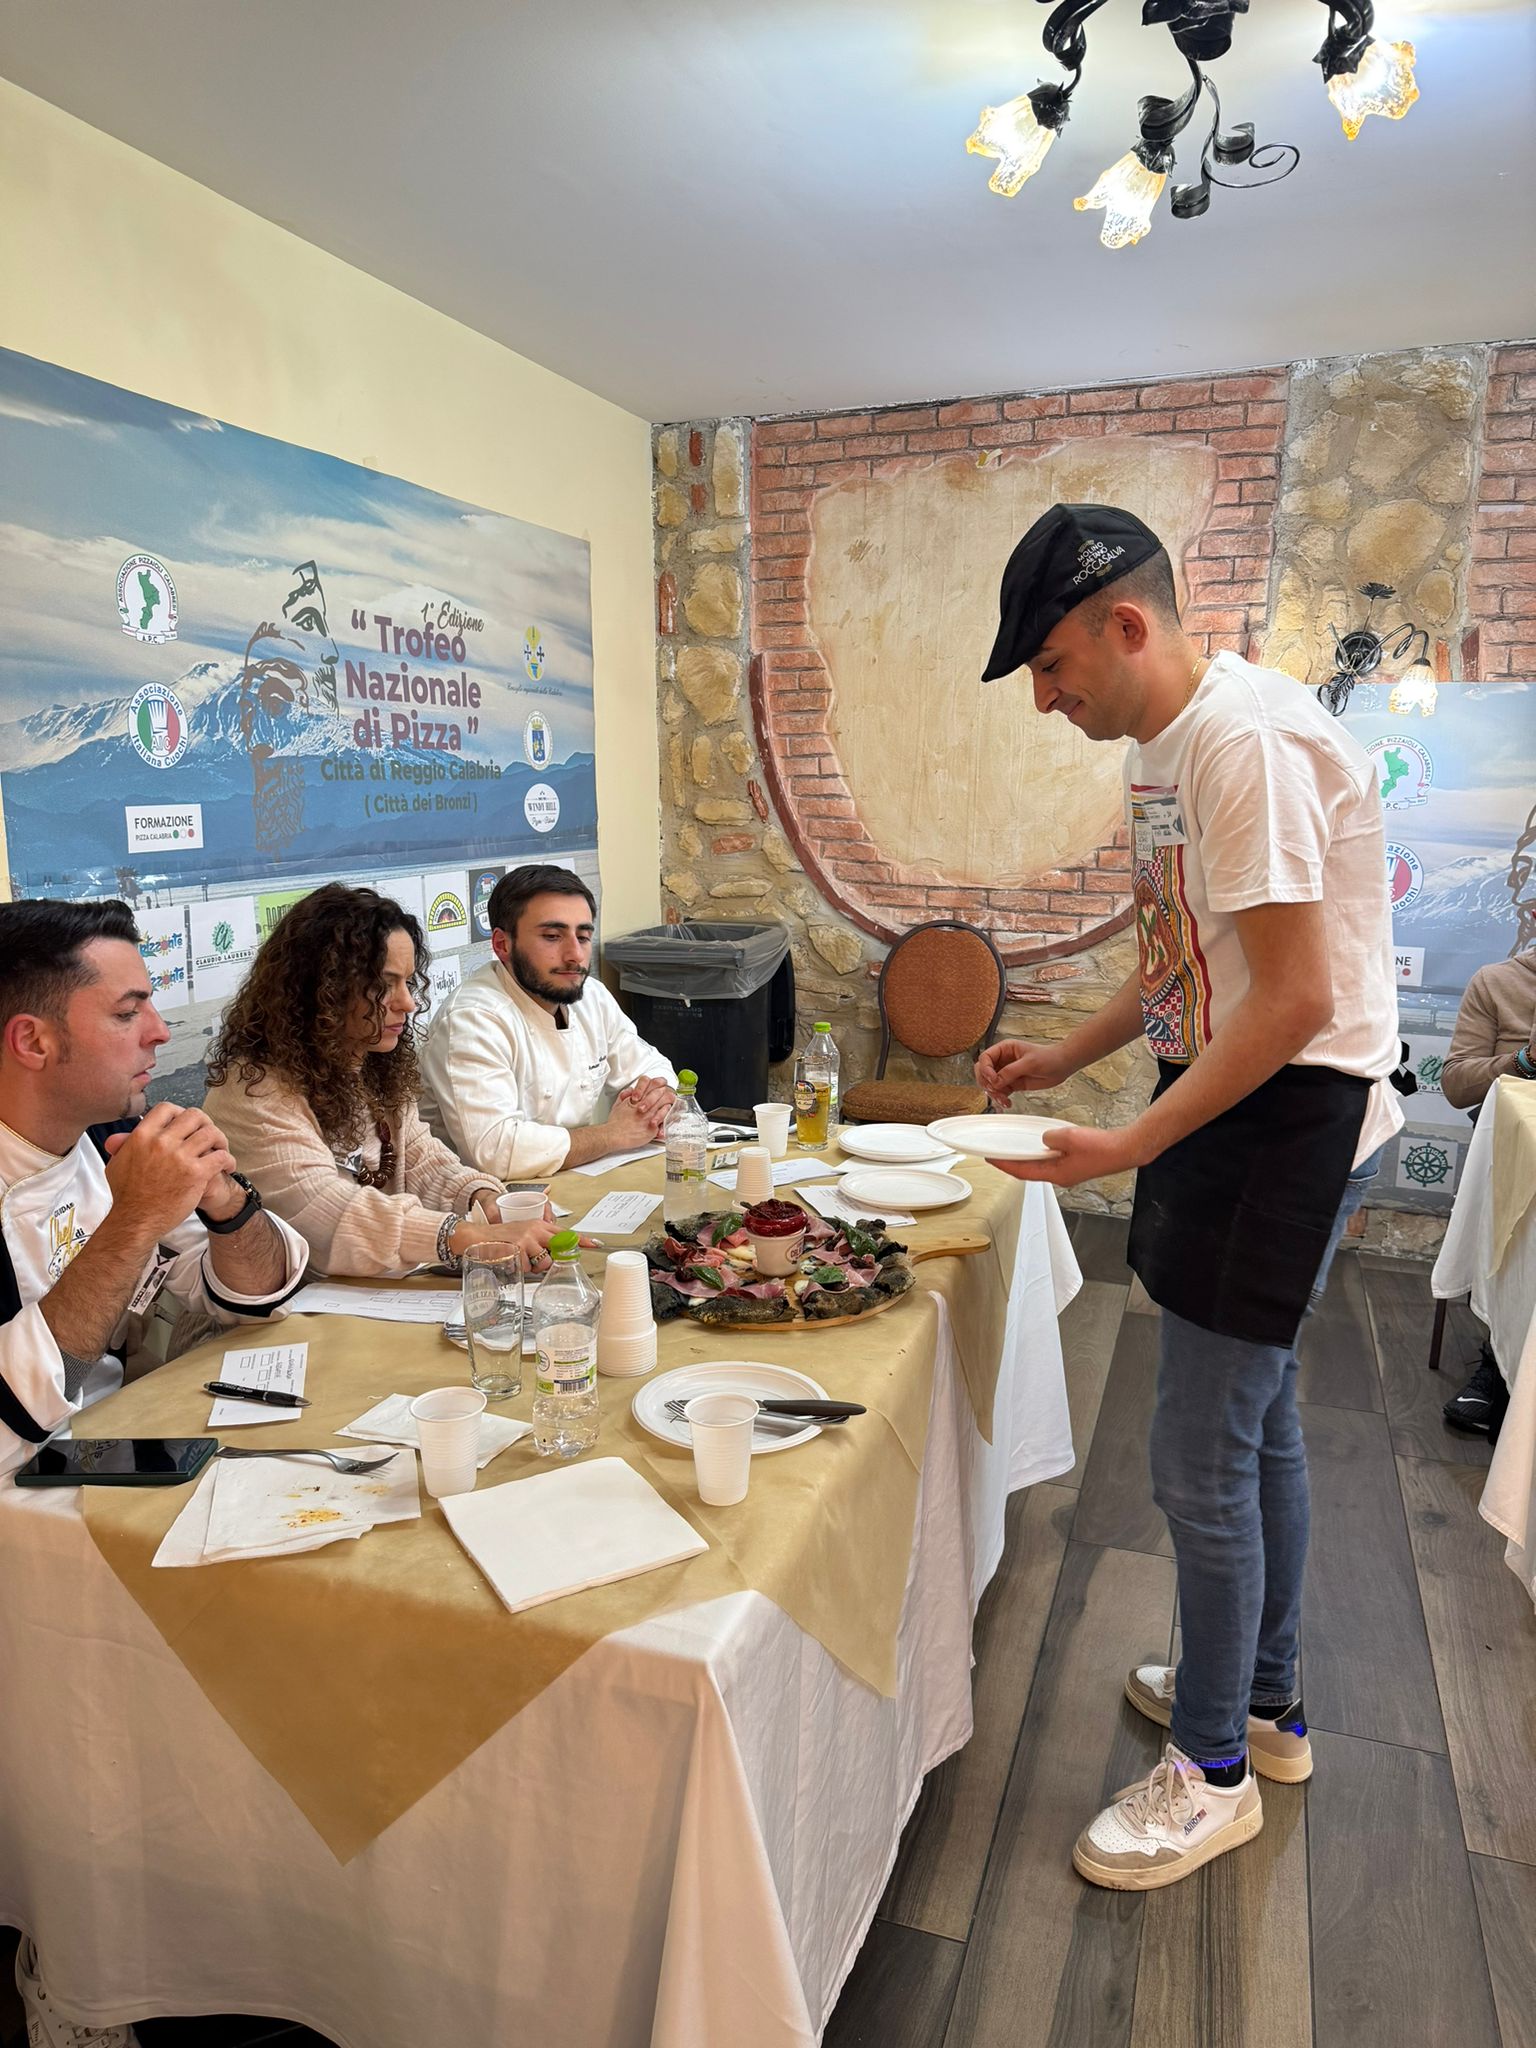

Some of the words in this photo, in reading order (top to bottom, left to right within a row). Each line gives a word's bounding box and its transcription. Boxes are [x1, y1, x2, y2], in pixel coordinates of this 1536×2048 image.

[138, 557, 164, 574] PIZZAIOLI
[1072, 545, 1126, 585] ROCCASALVA
[1077, 541, 1104, 562] MOLINO
[437, 600, 485, 636] Edizione
[345, 659, 482, 709] Nazionale
[130, 684, 183, 716] Associazione
[353, 706, 383, 749] di
[132, 734, 162, 767] Italiana
[164, 735, 187, 767] Cuochi
[320, 756, 365, 781] Città
[369, 756, 386, 781] di
[391, 759, 446, 786] Reggio
[450, 759, 502, 781] Calabria
[412, 793, 432, 813] dei
[134, 815, 194, 829] FORMAZIONE
[135, 833, 150, 841] PIZZA
[150, 832, 172, 841] CALABRIA
[75, 1227, 86, 1239] di
